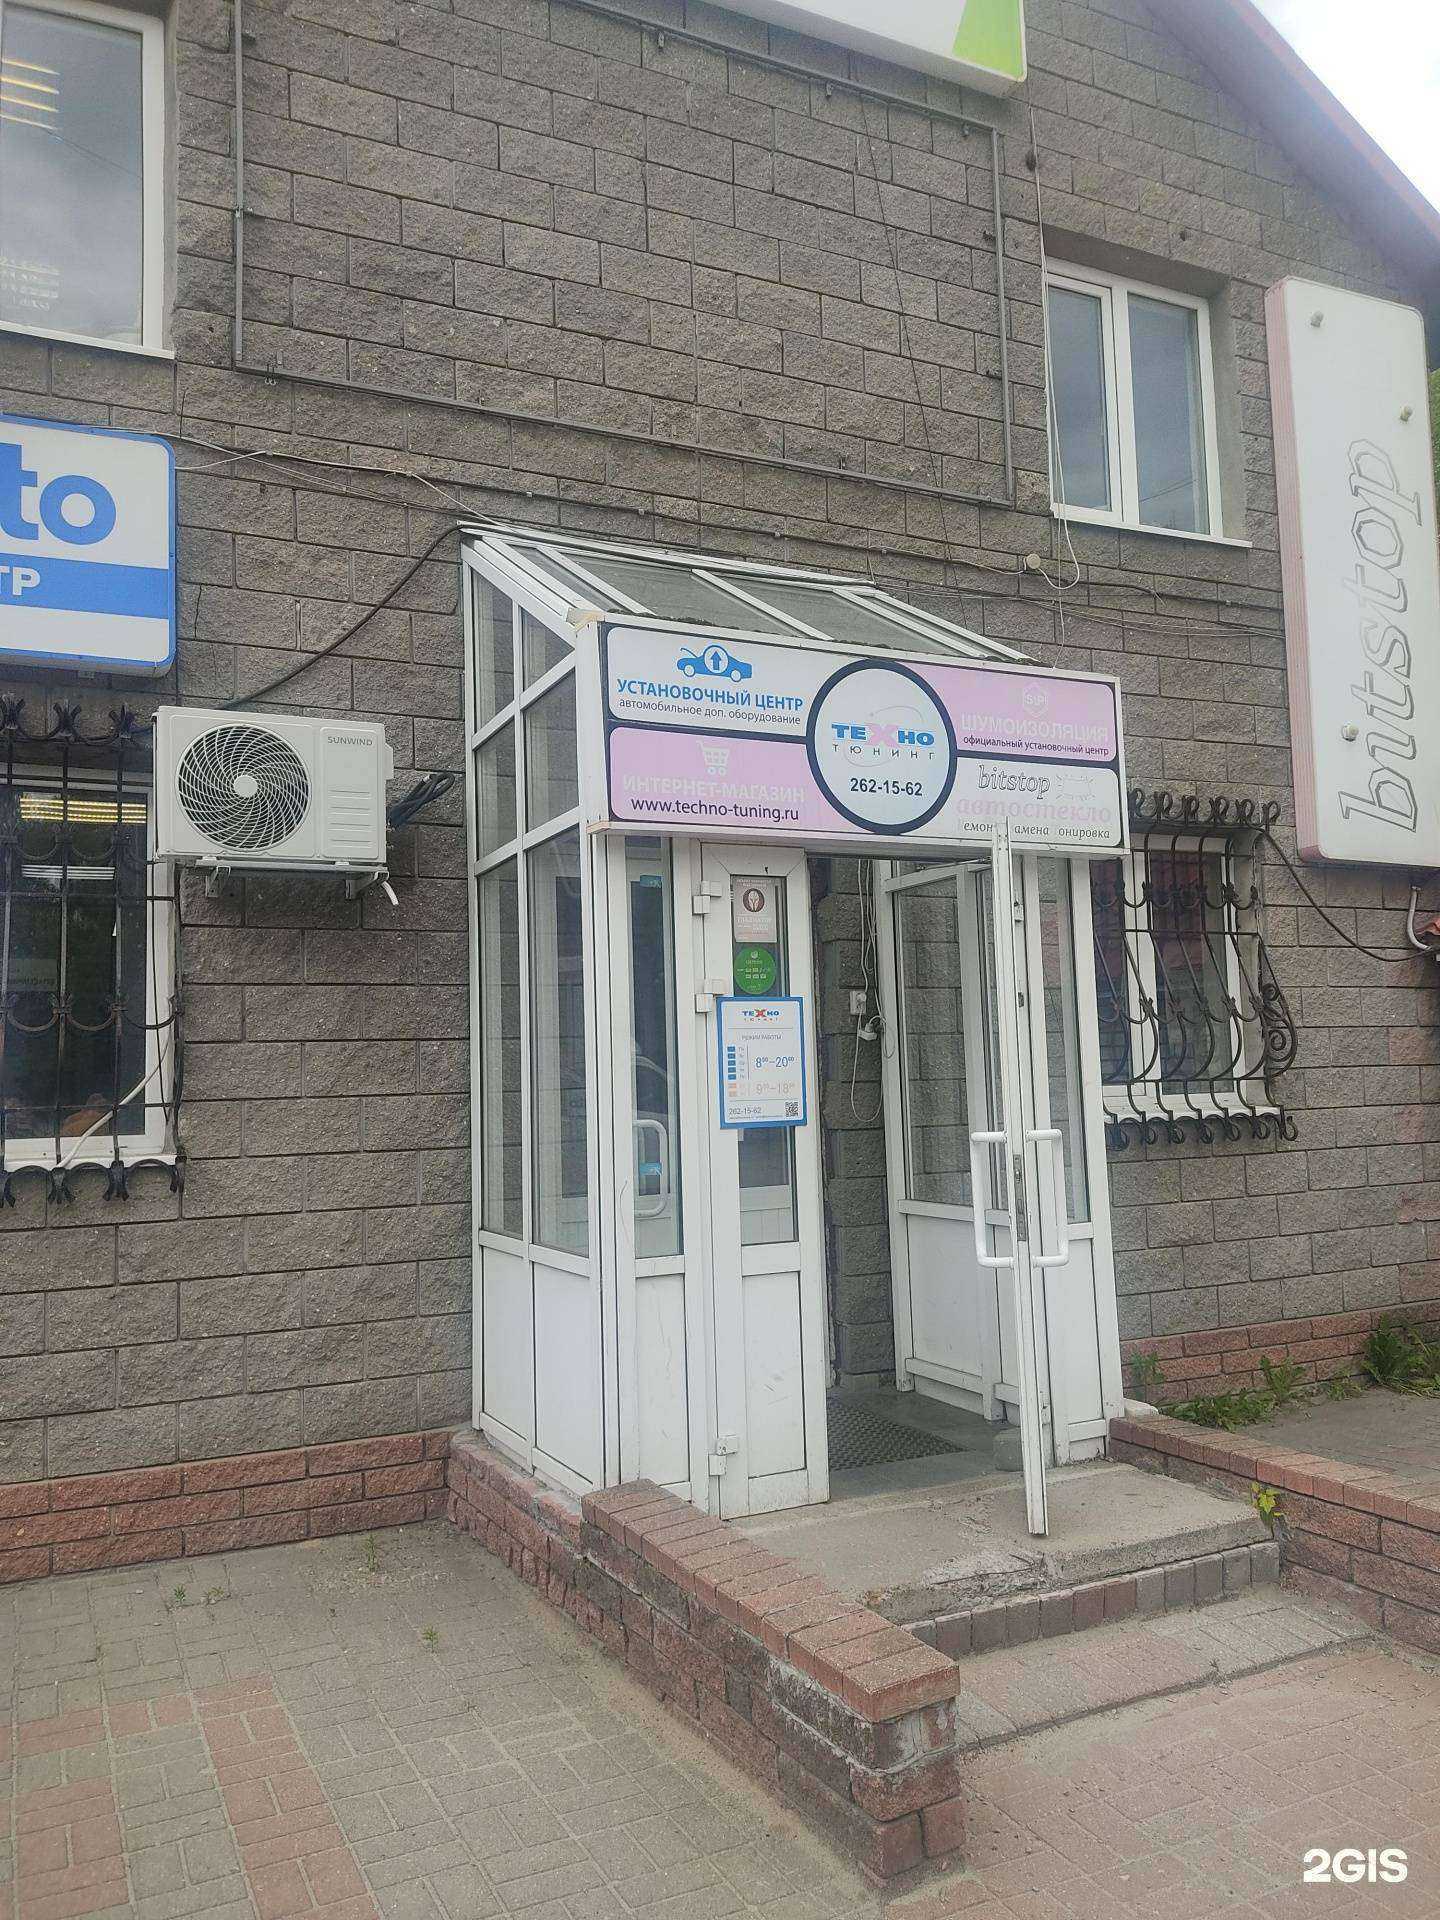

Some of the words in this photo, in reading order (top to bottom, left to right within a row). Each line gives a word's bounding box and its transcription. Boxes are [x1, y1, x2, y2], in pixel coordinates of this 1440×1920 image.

[617, 678, 751, 706] УСТАНОВОЧНЫЙ
[754, 693, 804, 712] ЦЕНТР
[618, 699, 702, 716] автомобильное
[704, 708, 725, 719] доп.
[728, 709, 802, 726] оборудование
[327, 736, 373, 747] SUNWIND
[831, 722, 935, 748] ТЕХНО
[960, 713, 1109, 743] ШУМОИЗОЛЯЦИЯ
[963, 735, 1023, 750] официальный
[1024, 741, 1084, 754] установочный
[1085, 746, 1110, 757] центр
[623, 775, 806, 803] ИНТЕРНЕТ-МАГАЗИН
[849, 777, 923, 797] 262-15-62
[977, 763, 1051, 800] bitstop
[631, 799, 800, 823] www.techno-tuning.ru
[955, 797, 1112, 824] автостекло
